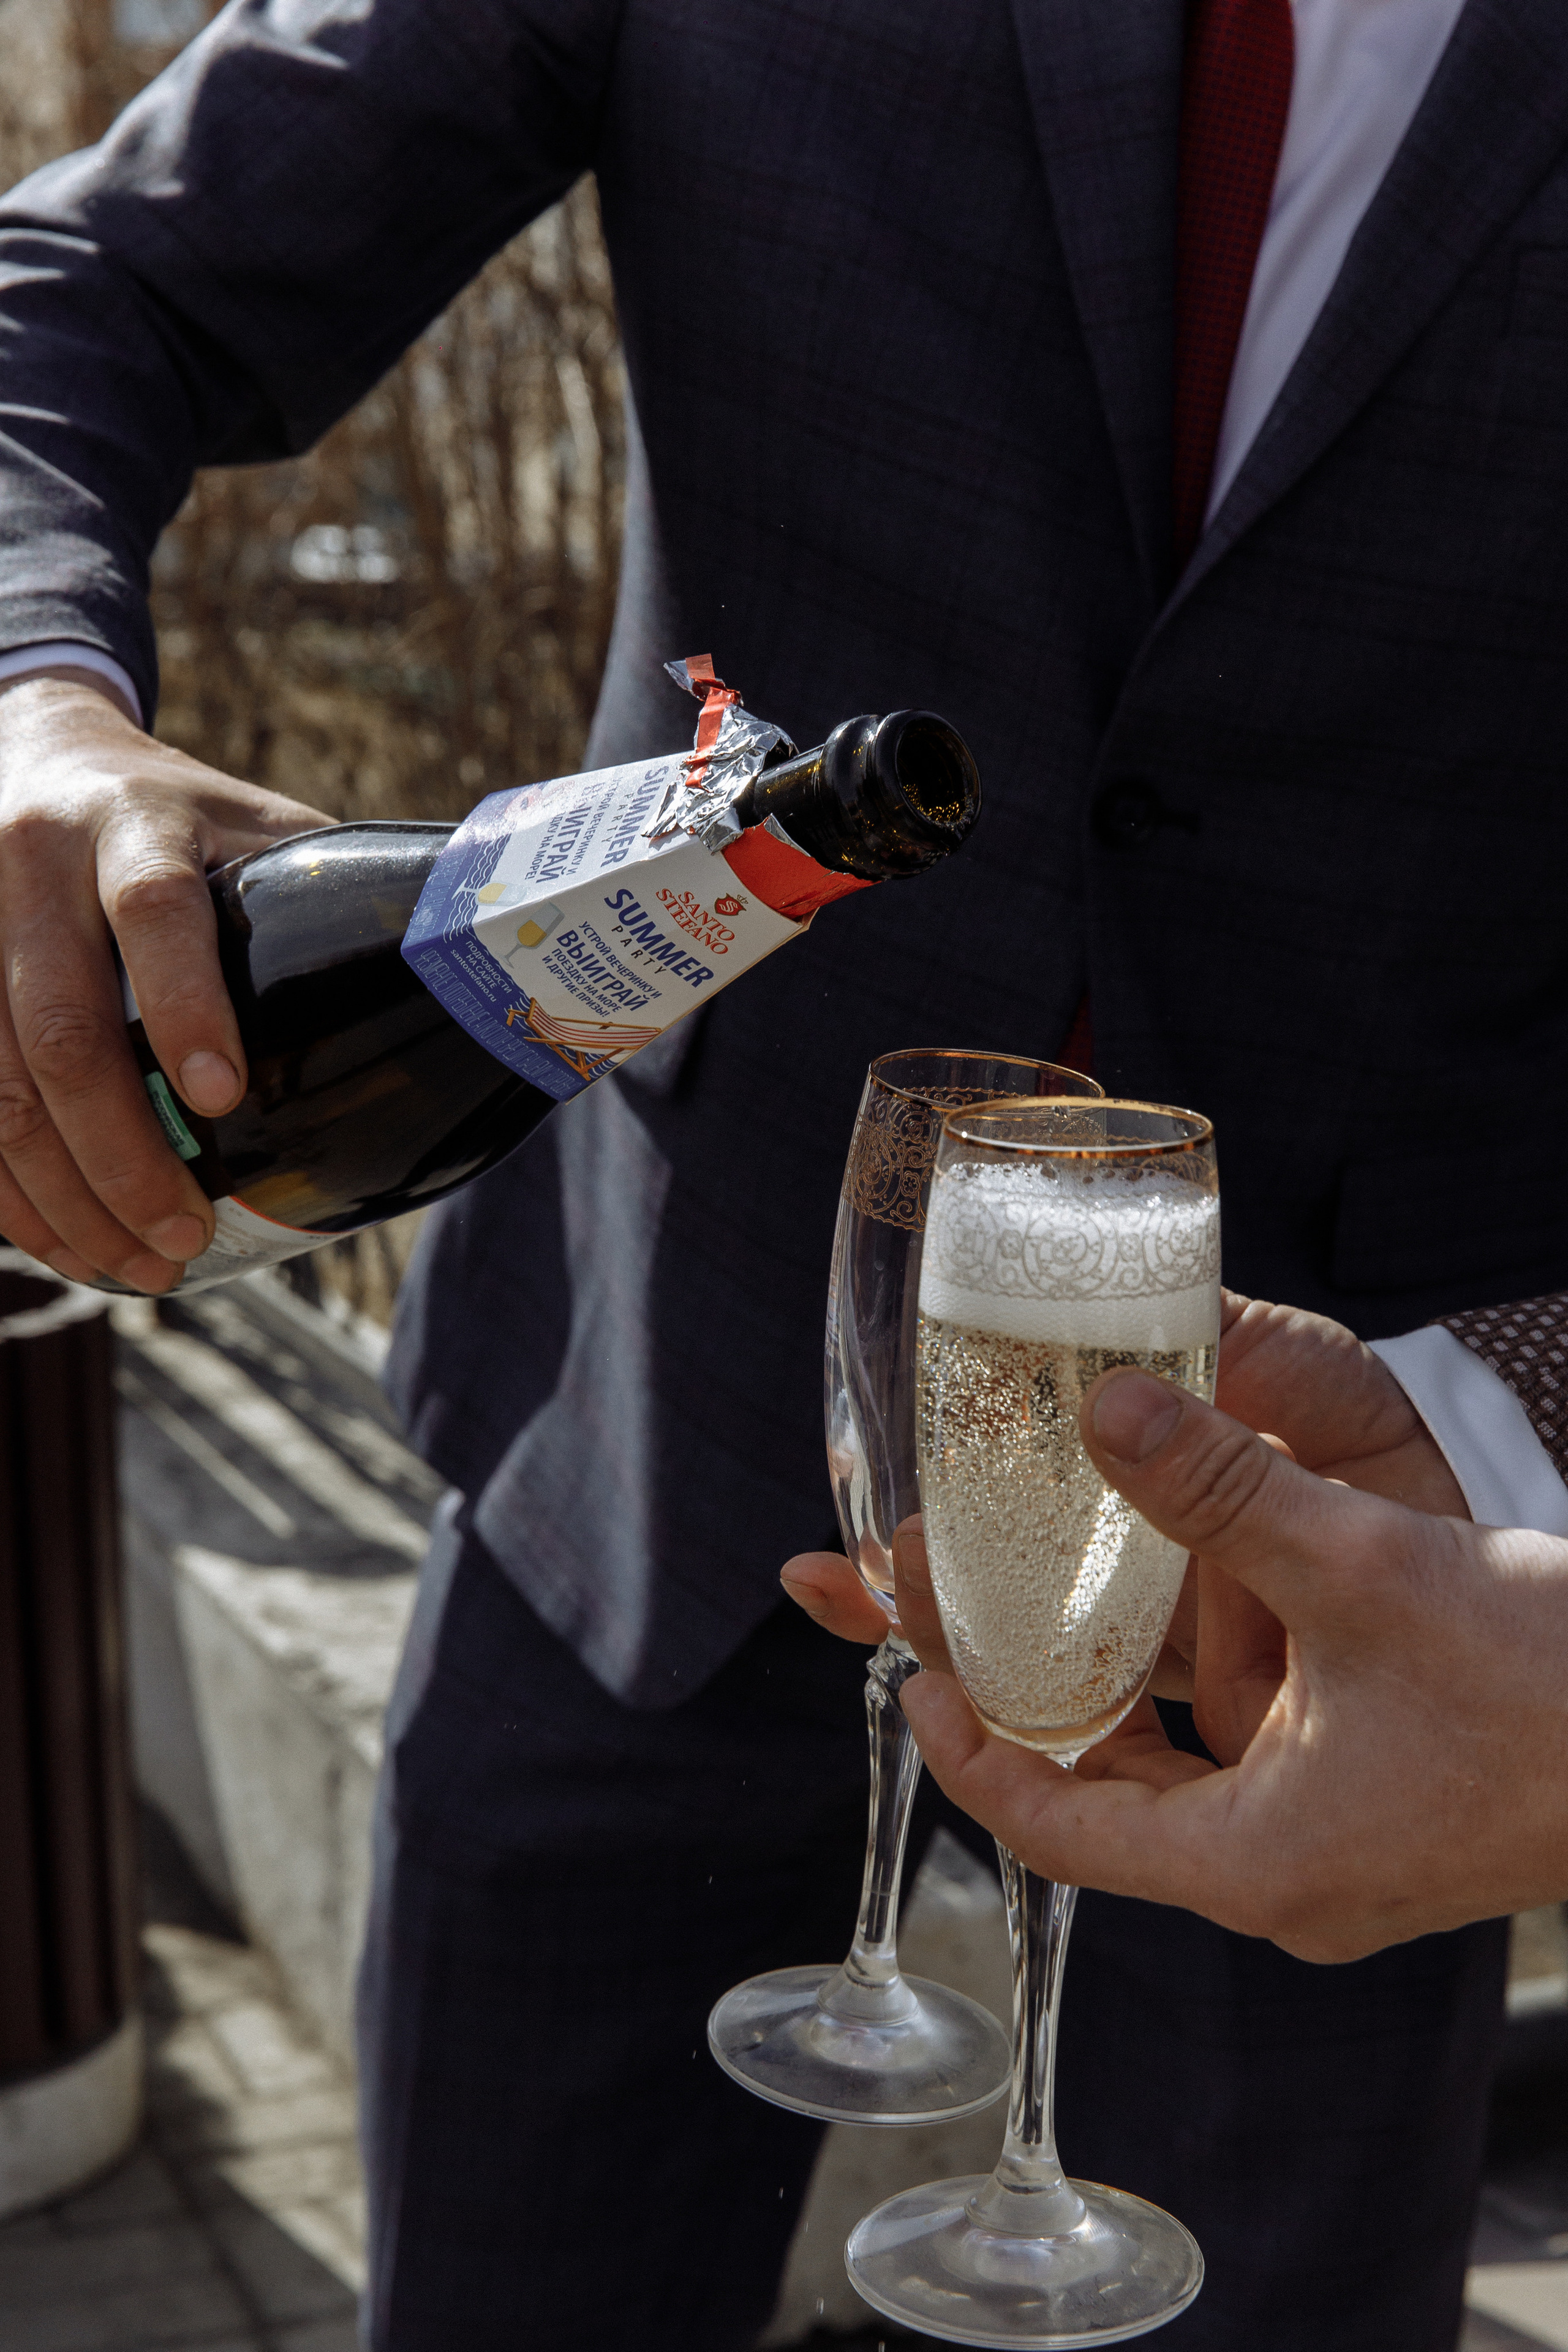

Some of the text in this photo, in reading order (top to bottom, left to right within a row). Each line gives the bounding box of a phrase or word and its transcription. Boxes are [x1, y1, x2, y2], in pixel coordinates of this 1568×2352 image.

[538, 835, 554, 850] НА
[571, 812, 605, 865] ВЕЧЕРИНКУ
[600, 766, 669, 867] SUMMER
[601, 793, 635, 843] PARTY
[524, 851, 547, 880] МОРЕ!
[566, 867, 578, 876] И
[603, 888, 714, 988] SUMMER
[655, 888, 728, 954] STEFANO
[677, 891, 735, 941] SANTO
[450, 949, 497, 1003] santostefano.ru
[466, 940, 512, 993] ПОДРОБНОСТИ
[466, 954, 497, 989] НА САЙТЕ
[556, 929, 650, 1011] ВЫИГРАЙ
[579, 921, 662, 999] УСТРОЙ ВЕЧЕРИНКУ И
[611, 925, 666, 974] PARTY
[414, 948, 458, 990] ЧРЕЗМЕРНОЕ
[438, 980, 490, 1027] УПОТРЕБЛЕНИЕ
[542, 955, 610, 1017] И ДРУГИЕ ПРИЗЫ!
[551, 948, 622, 1012] ПОЕЗДКУ НА МОРЕ
